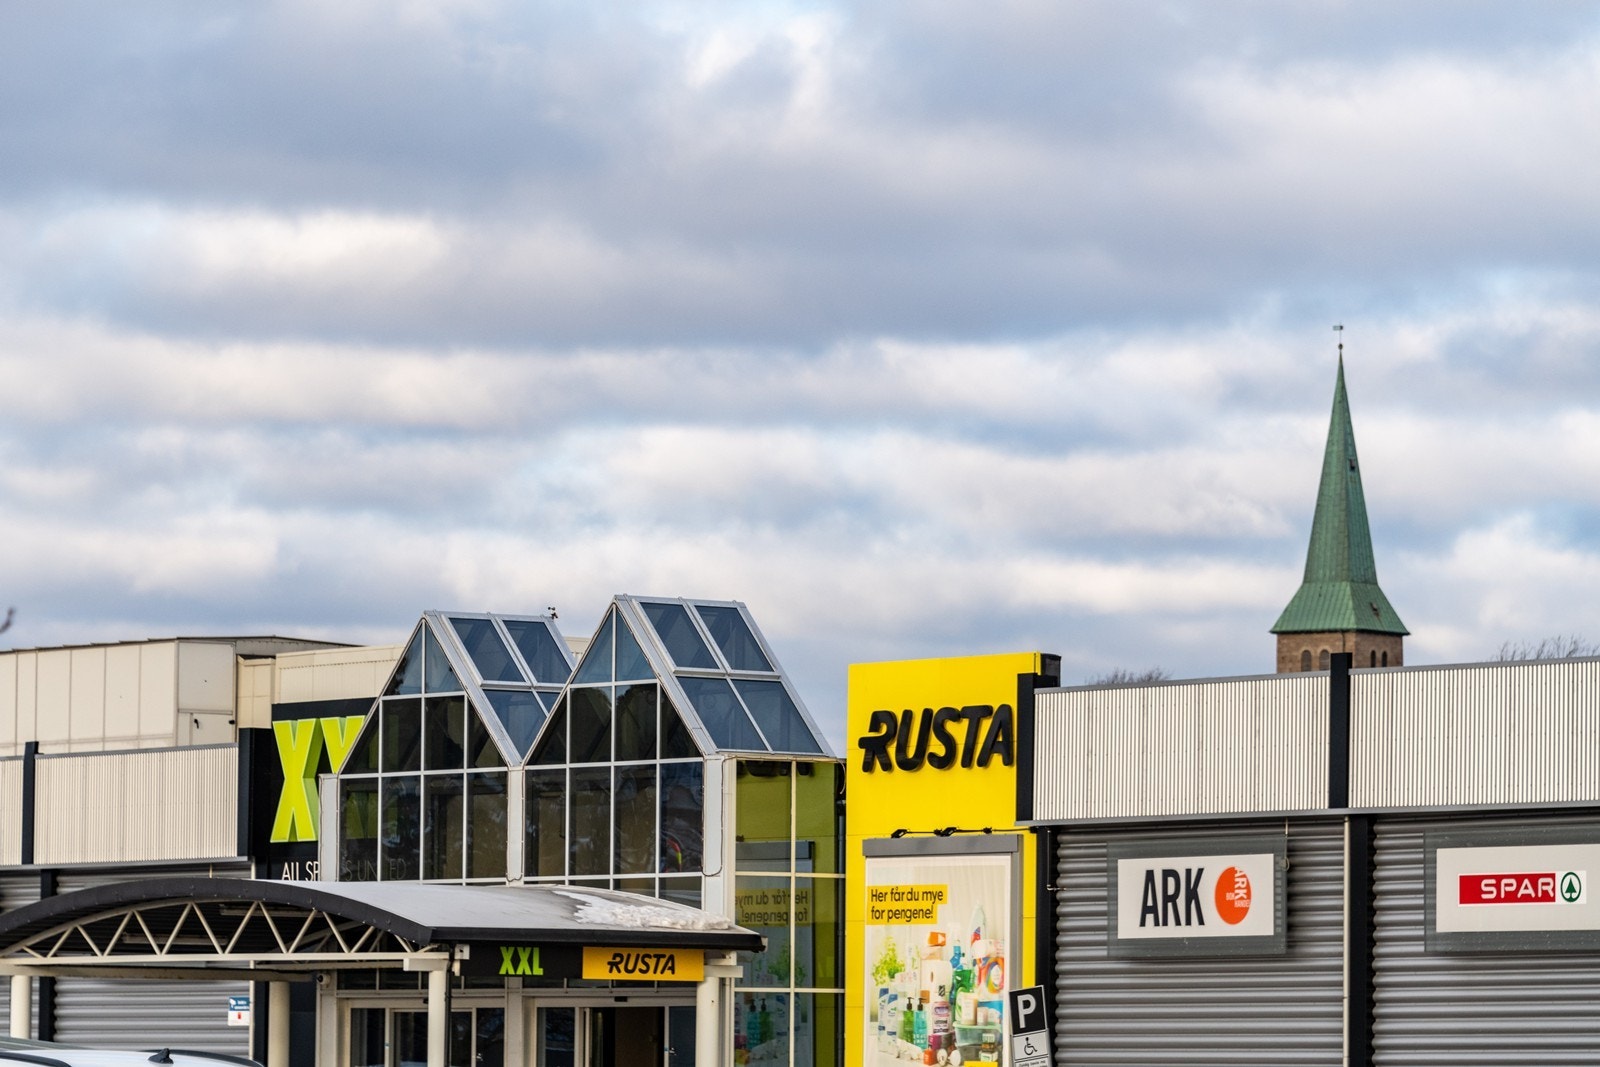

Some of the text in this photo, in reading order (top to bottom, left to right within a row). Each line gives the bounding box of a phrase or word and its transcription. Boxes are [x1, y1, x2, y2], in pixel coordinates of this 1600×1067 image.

[858, 703, 1015, 773] RUSTA
[357, 858, 407, 881] UNED
[871, 886, 943, 904] Her får du mye
[1139, 867, 1205, 927] ARK
[1481, 877, 1555, 899] SPAR
[871, 904, 933, 923] for pengene!
[499, 946, 543, 975] XXL
[607, 952, 676, 975] RUSTA
[1017, 993, 1036, 1029] P
